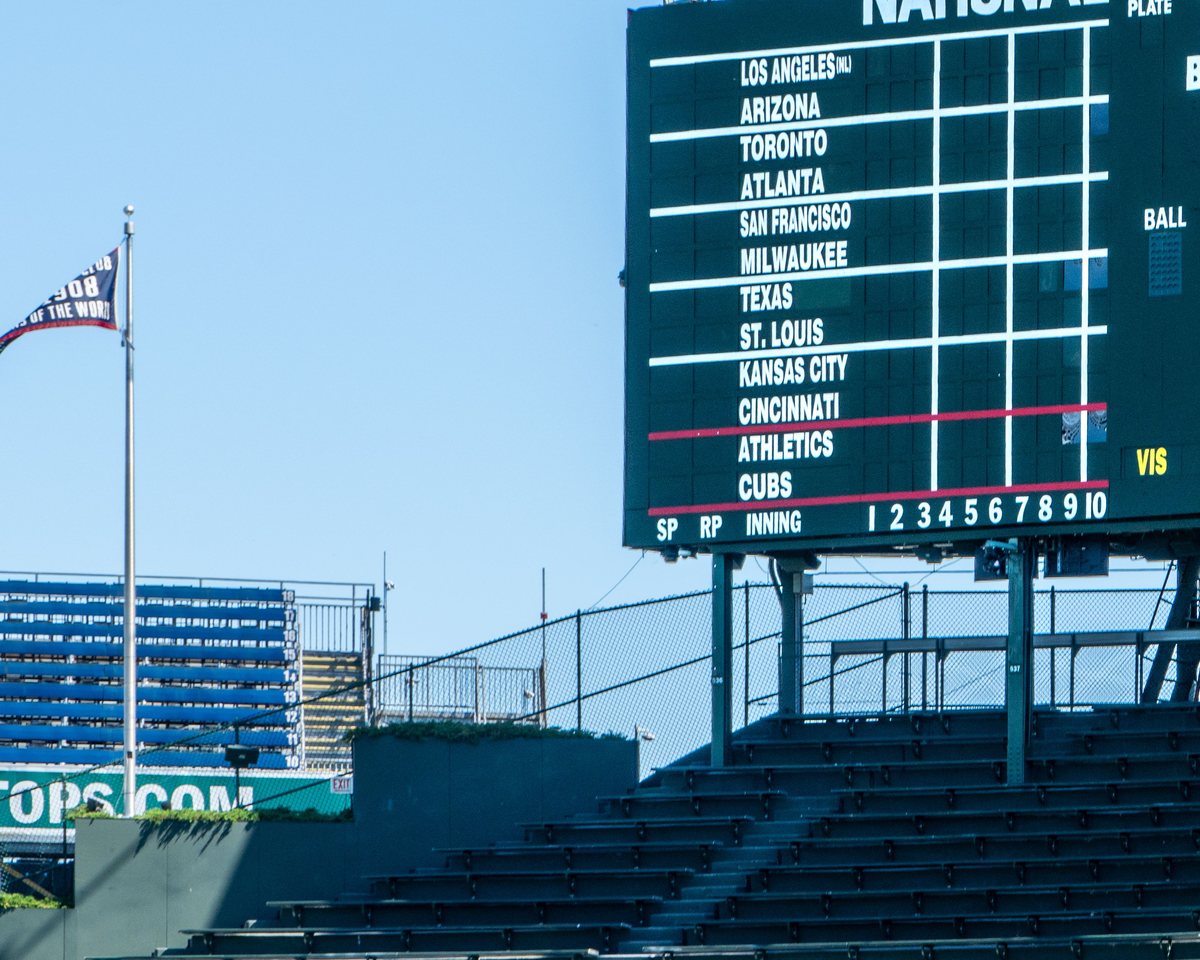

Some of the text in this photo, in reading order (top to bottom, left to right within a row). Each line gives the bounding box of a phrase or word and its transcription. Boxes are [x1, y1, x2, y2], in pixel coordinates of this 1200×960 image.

[741, 59, 767, 86] LOS
[741, 92, 820, 124] ARIZONA
[740, 129, 827, 161] TORONTO
[741, 168, 824, 199] ATLANTA
[740, 202, 851, 237] SAN FRANCISCO
[1144, 206, 1186, 230] BALL
[741, 241, 848, 275] MILWAUKEE
[44, 275, 99, 305] 908
[740, 283, 792, 312] TEXAS
[29, 309, 45, 324] OF
[47, 302, 74, 320] THE
[740, 318, 823, 349] ST. LOUIS
[740, 354, 848, 387] KANSAS CITY
[739, 393, 839, 425] CINCINNATI
[738, 430, 833, 462] ATHLETICS
[1137, 448, 1168, 475] VIS
[739, 471, 792, 500] CUBS
[657, 492, 1106, 541] SP RP INNING 1 2 3 4 5 6 7 8 9 10
[283, 670, 297, 682] 14
[283, 691, 297, 703] 13
[285, 711, 298, 723] 12
[286, 733, 298, 745] 11
[285, 755, 299, 768] 10
[333, 778, 350, 789] EXIT
